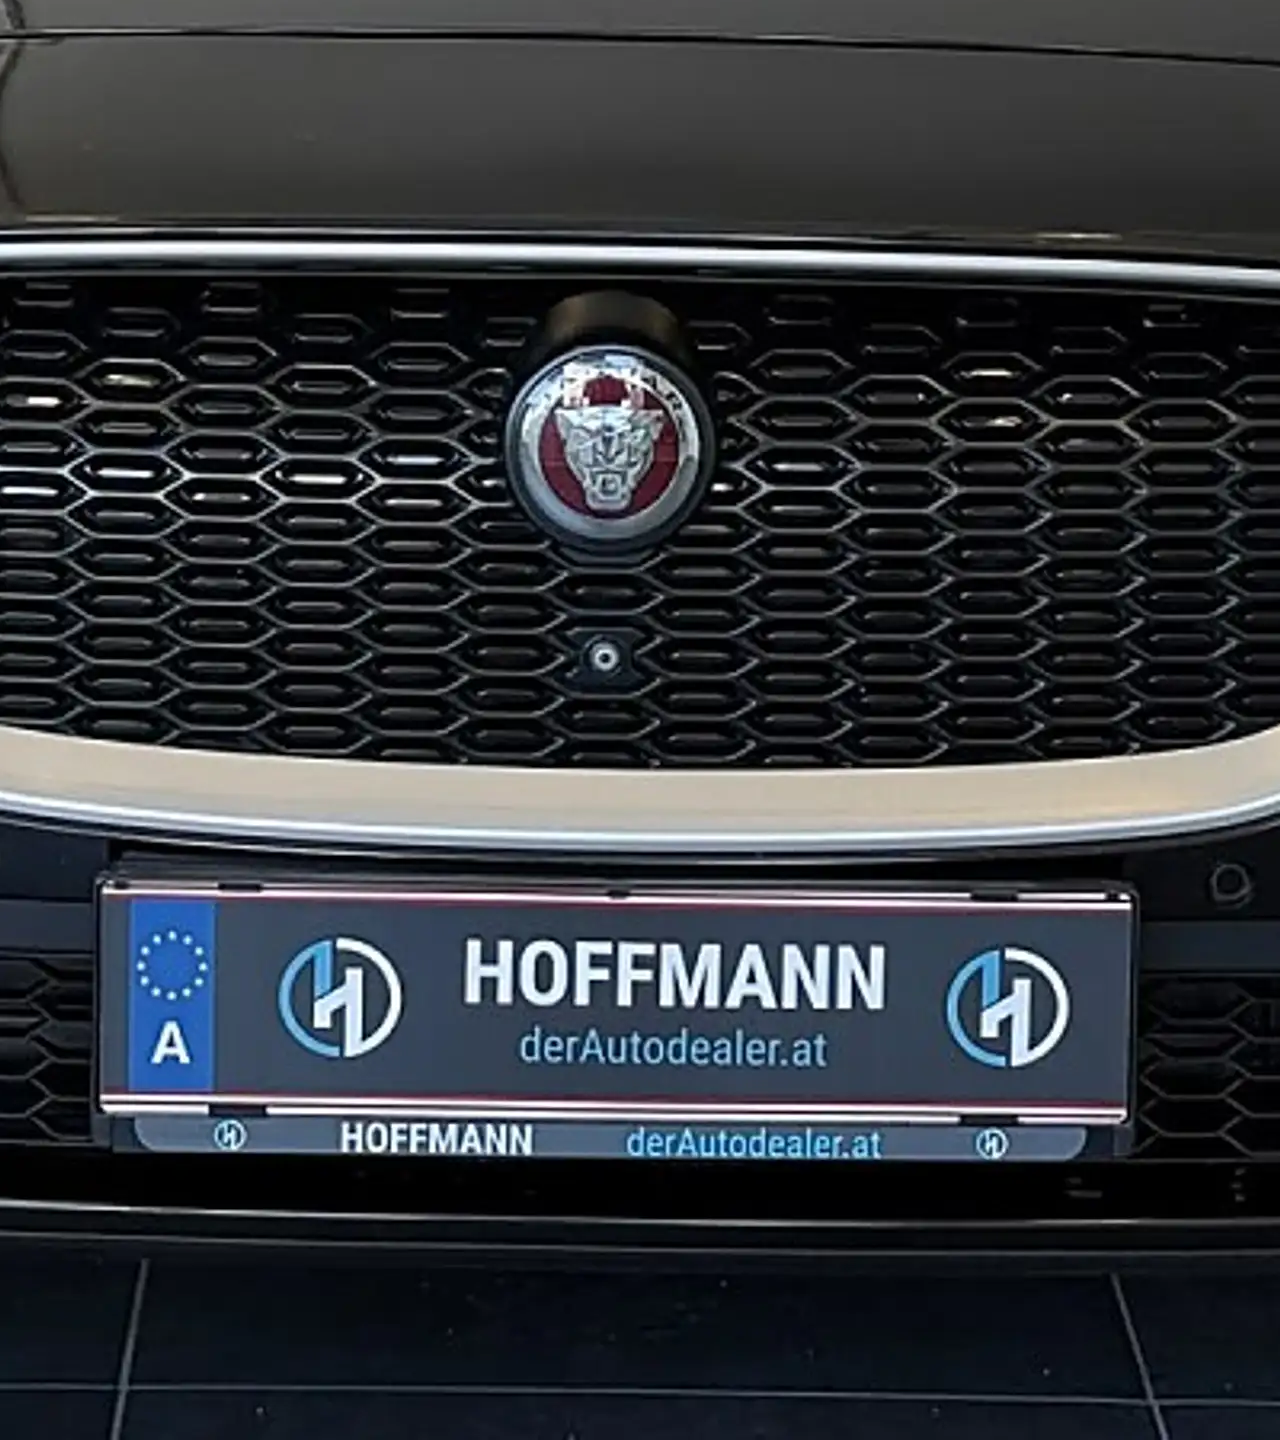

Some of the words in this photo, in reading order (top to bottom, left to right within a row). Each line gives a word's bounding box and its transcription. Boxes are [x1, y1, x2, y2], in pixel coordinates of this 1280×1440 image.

[464, 938, 885, 1010] HOFFMANN
[151, 1021, 191, 1065] A
[520, 1025, 827, 1068] derAutodealer.at
[340, 1121, 533, 1156] HOFFMANN
[626, 1126, 882, 1160] derAutodealer.at
